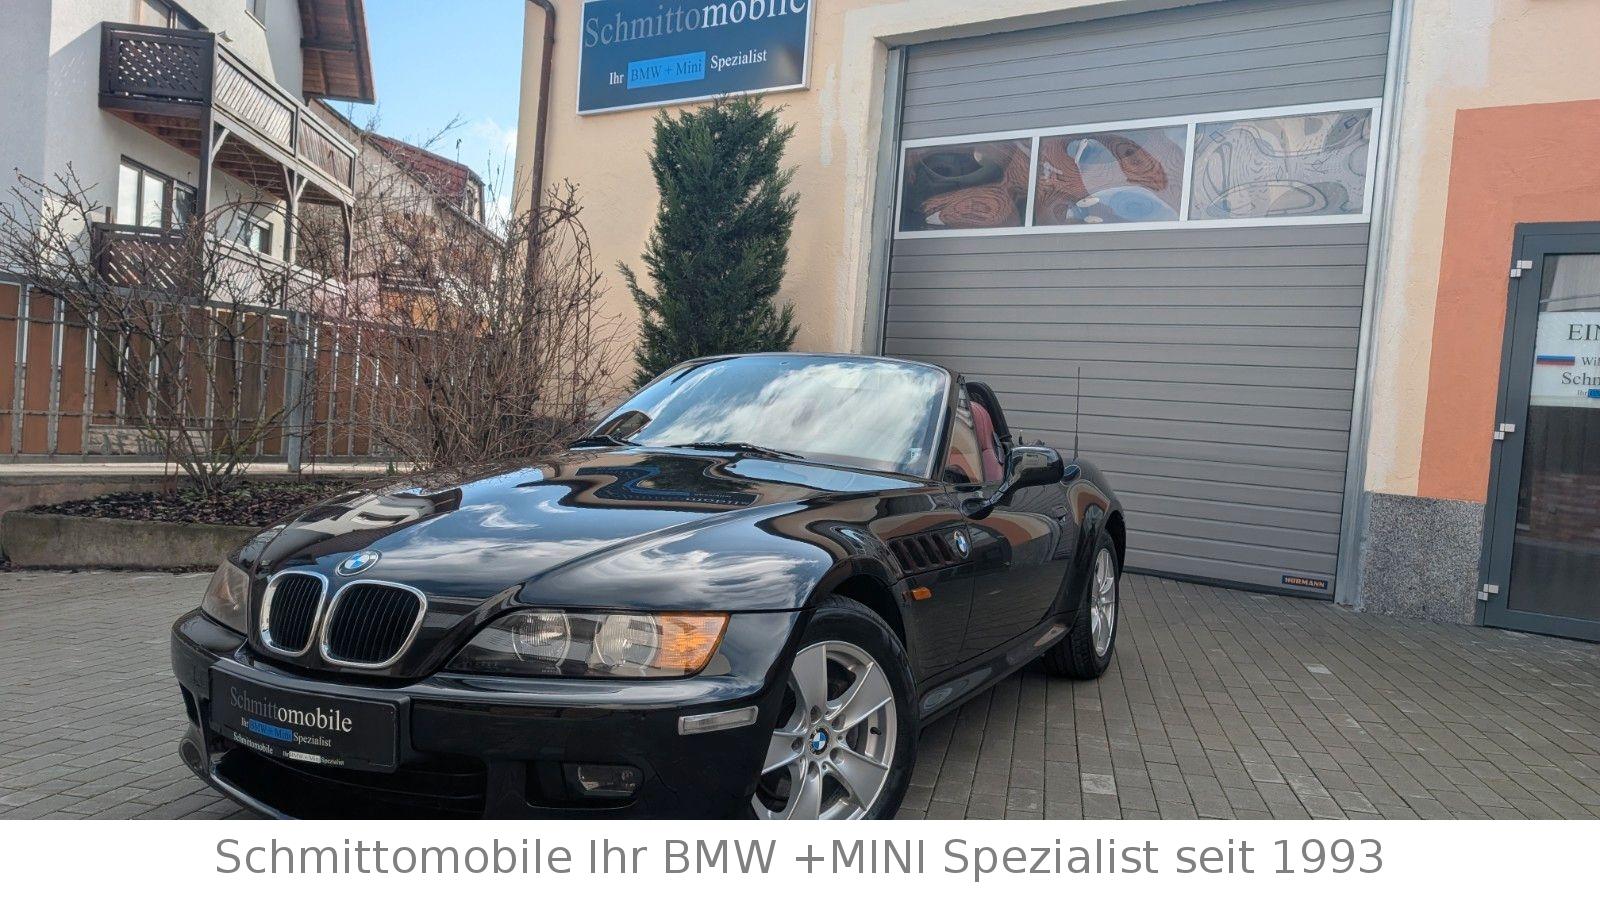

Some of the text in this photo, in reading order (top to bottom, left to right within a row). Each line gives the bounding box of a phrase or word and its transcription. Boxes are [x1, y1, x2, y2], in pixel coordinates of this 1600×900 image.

[609, 71, 625, 86] Ihr
[631, 66, 662, 82] BMW
[676, 59, 702, 76] Mini
[710, 49, 768, 72] Spezialist
[230, 686, 353, 733] Schmittomobile
[293, 731, 332, 748] Spezialist
